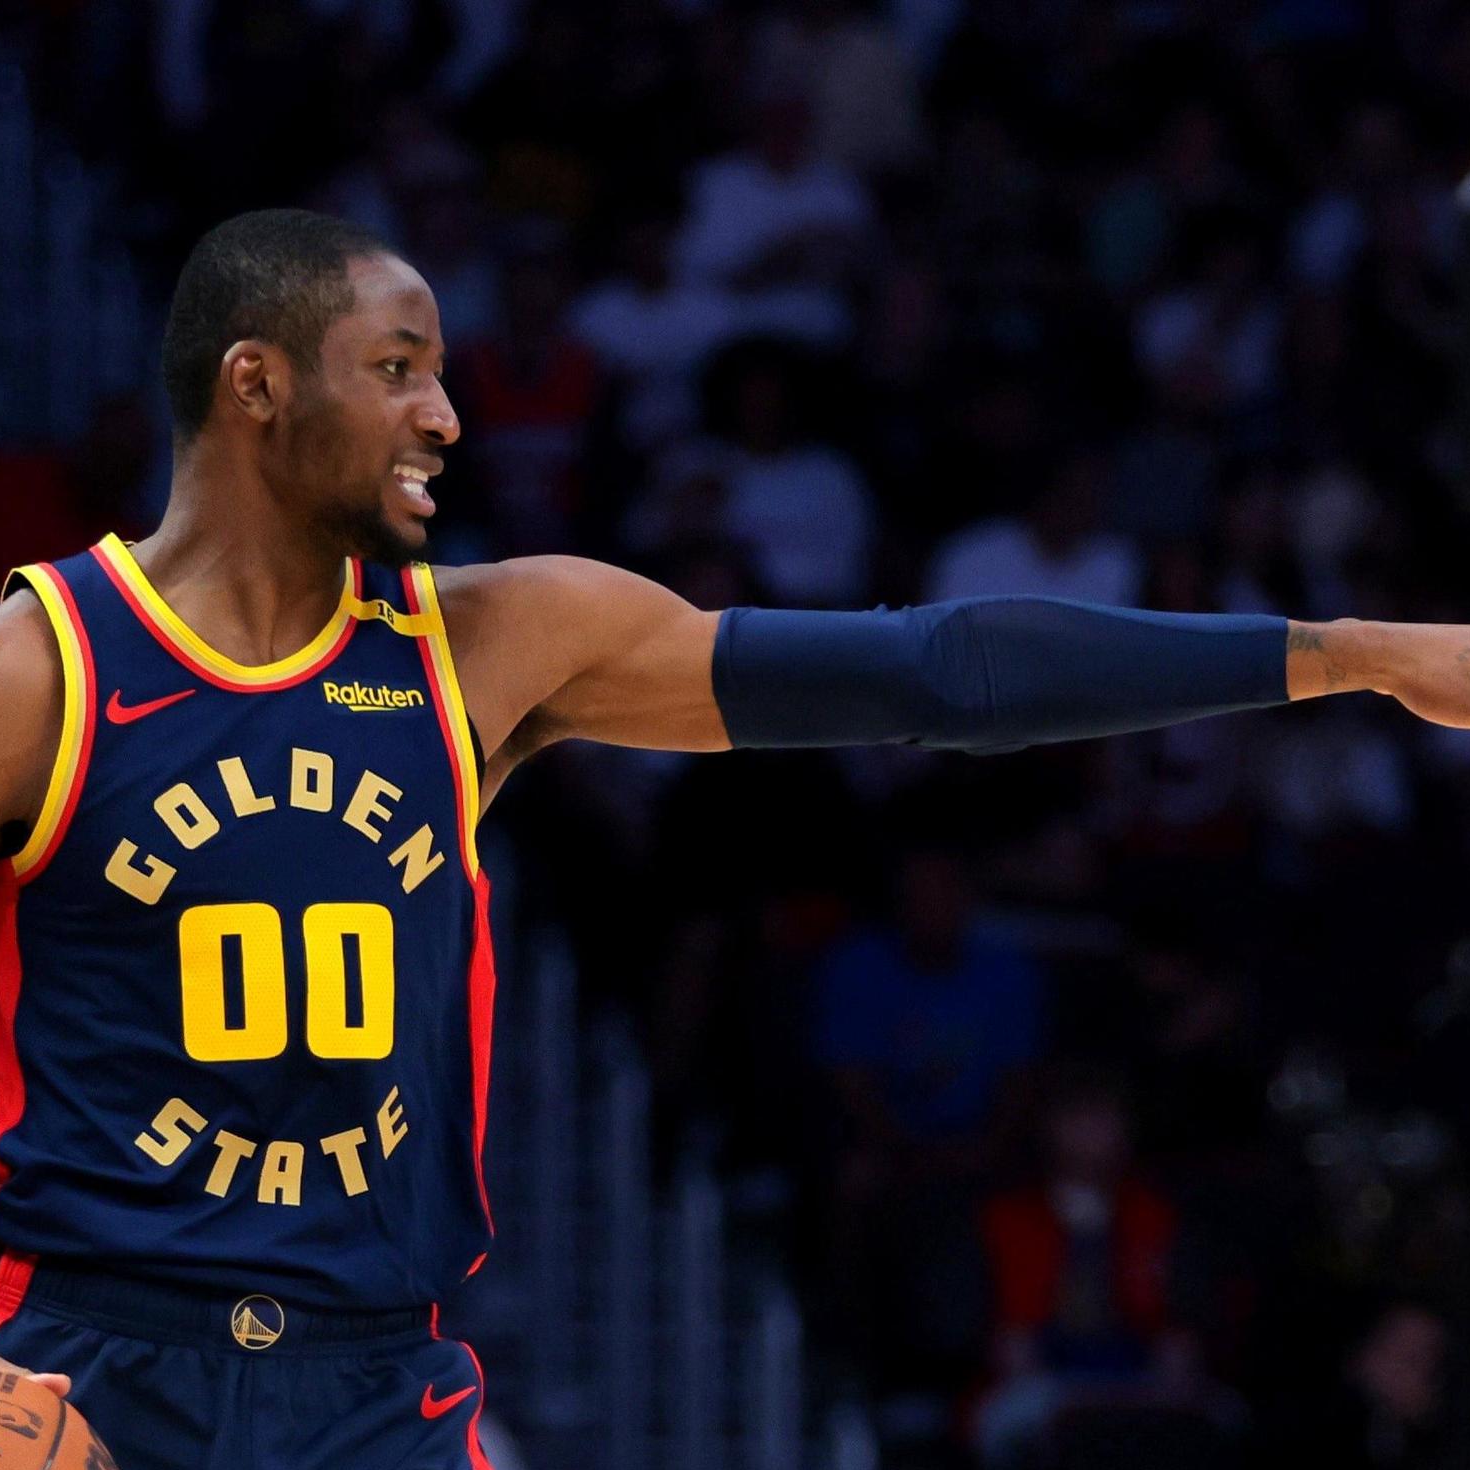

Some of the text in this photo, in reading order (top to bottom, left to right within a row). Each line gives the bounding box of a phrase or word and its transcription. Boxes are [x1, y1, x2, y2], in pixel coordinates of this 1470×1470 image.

[323, 681, 424, 709] Rakuten
[105, 748, 445, 905] GOLDEN
[179, 902, 394, 1062] 00
[135, 1085, 408, 1206] STATE
